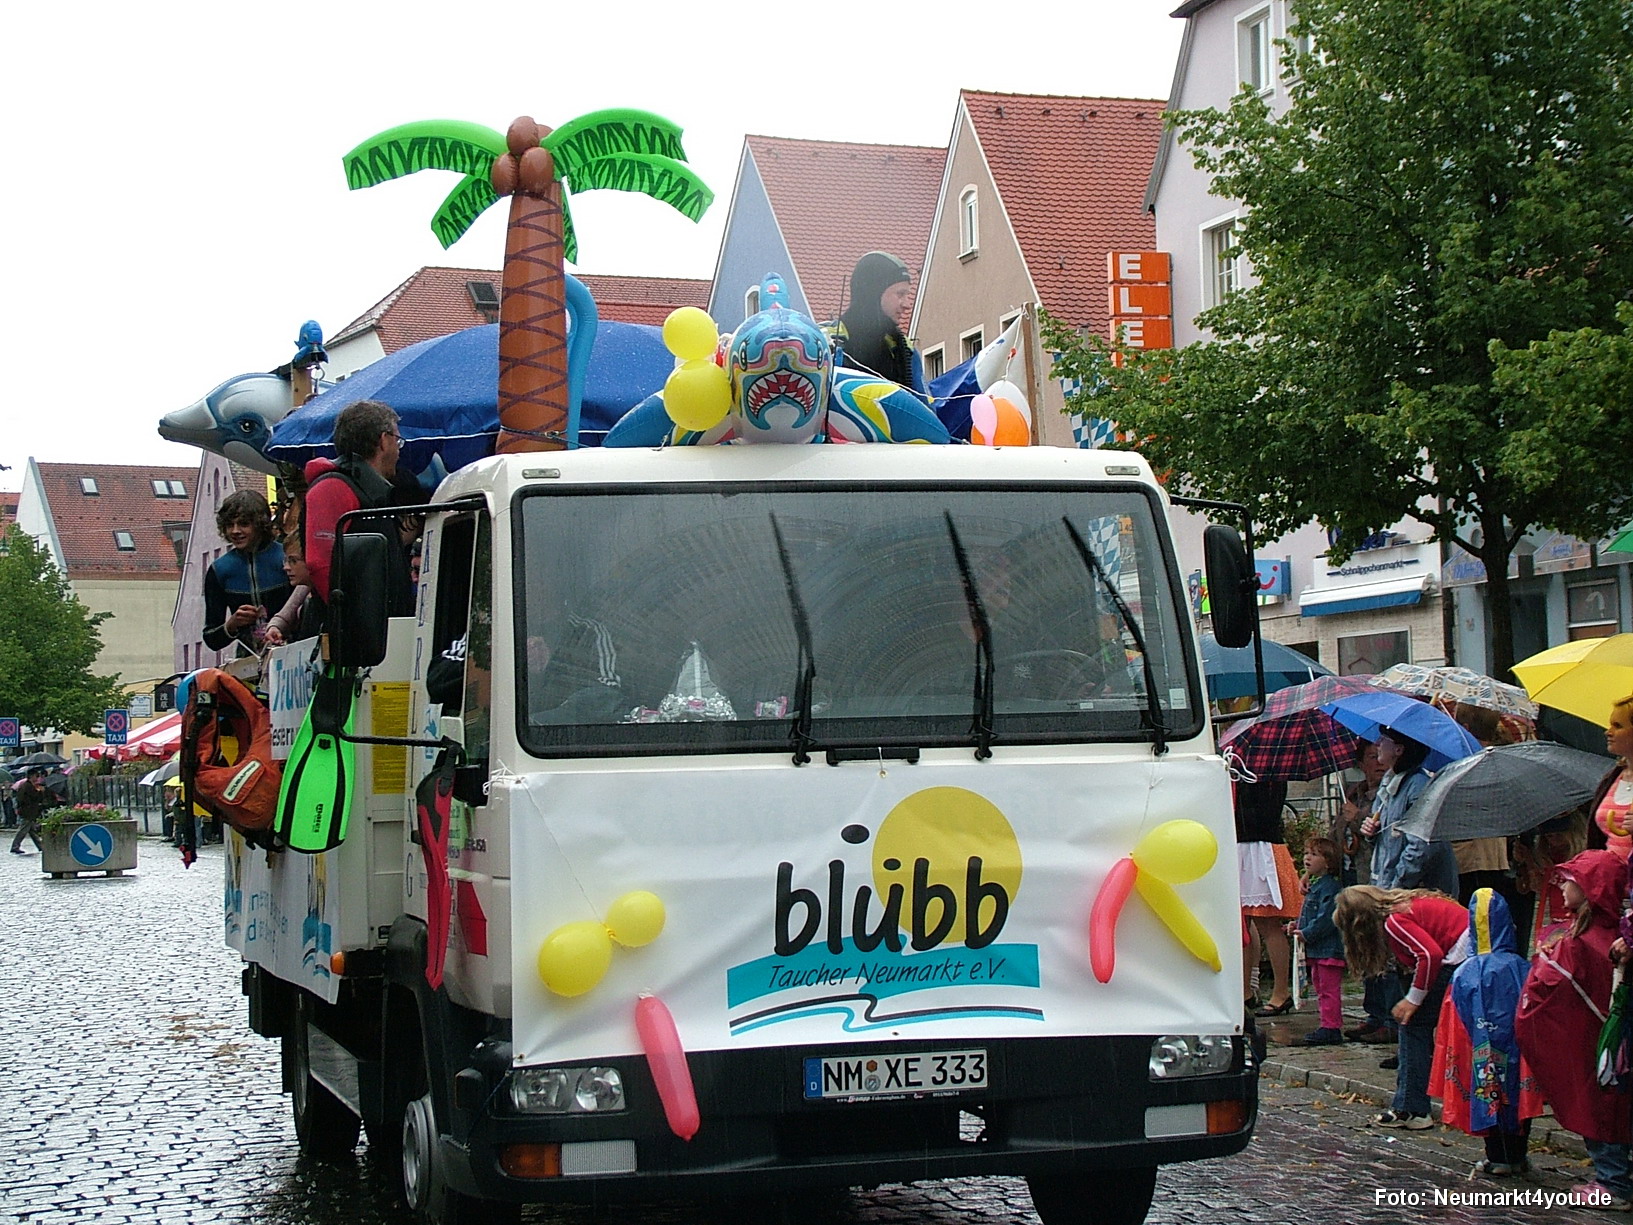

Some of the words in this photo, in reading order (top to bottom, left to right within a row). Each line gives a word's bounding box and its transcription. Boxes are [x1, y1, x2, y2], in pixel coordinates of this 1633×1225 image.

[107, 733, 126, 742] TAXI
[768, 964, 851, 988] Taucher
[855, 960, 964, 985] Neumarkt
[969, 957, 1006, 980] e.V.
[810, 1082, 817, 1091] D
[823, 1060, 863, 1092] NM
[884, 1057, 923, 1089] XE
[931, 1053, 986, 1086] 333
